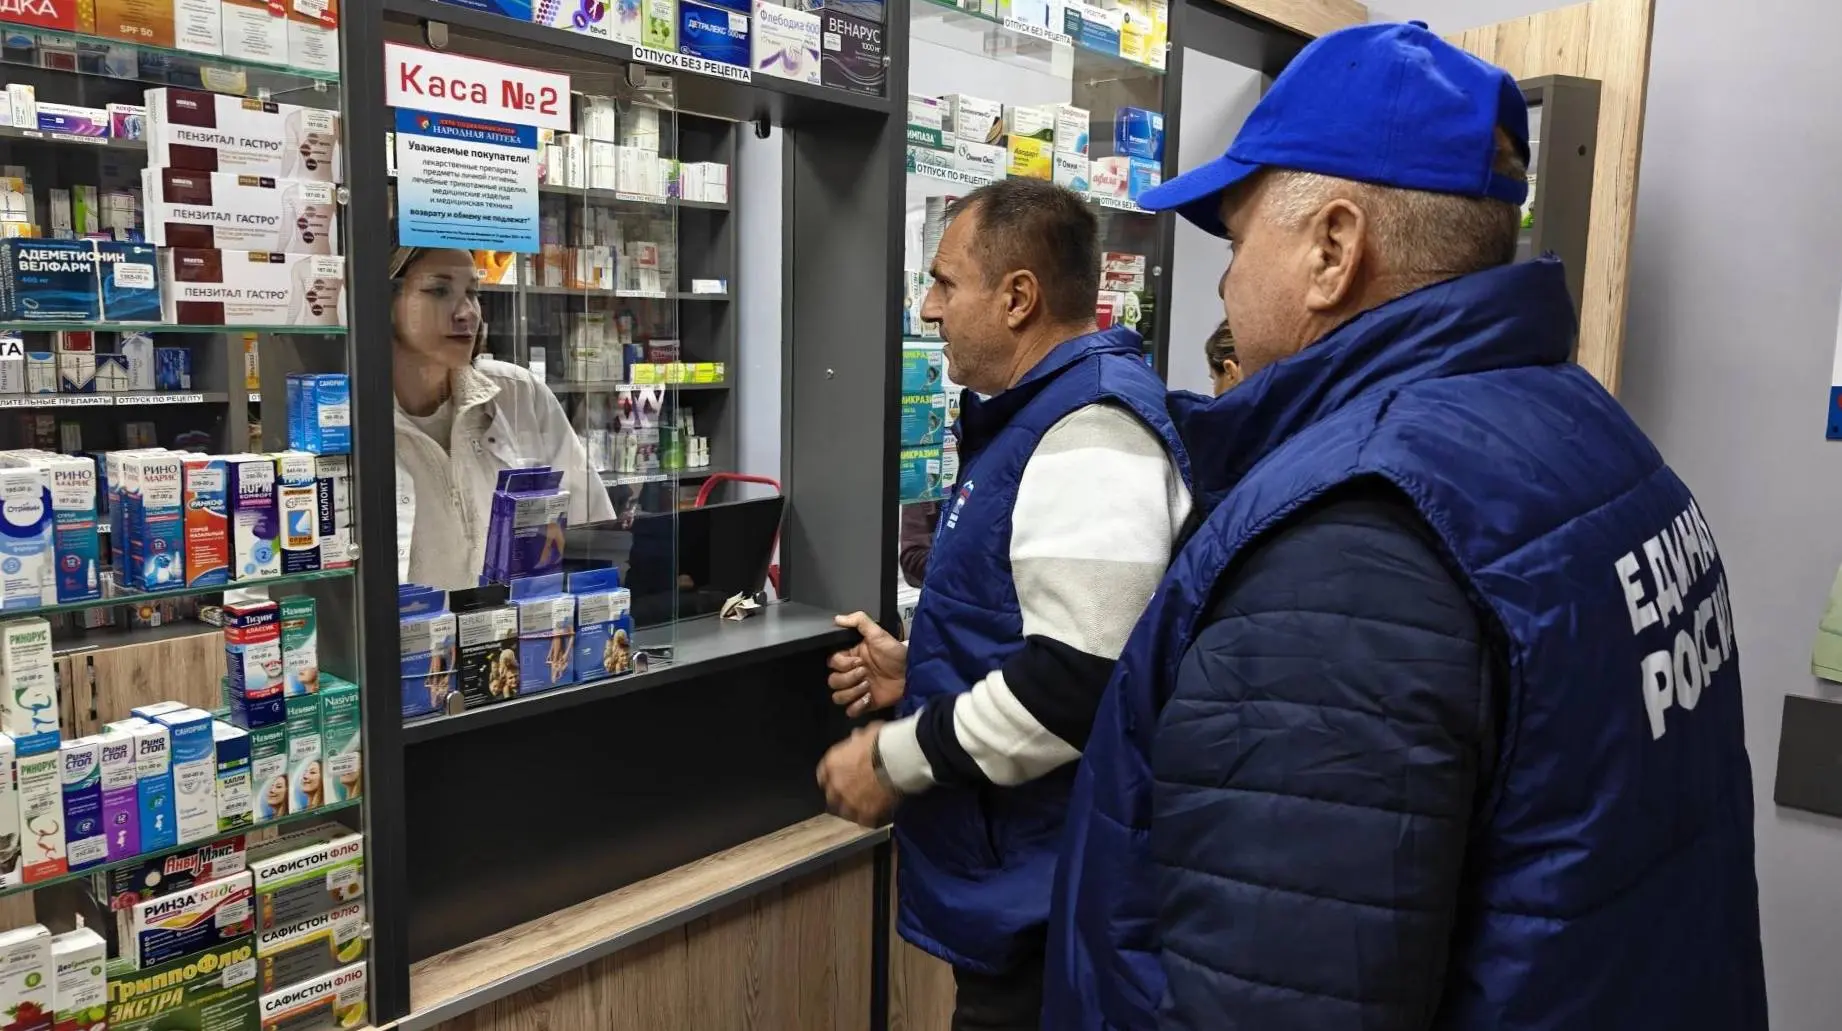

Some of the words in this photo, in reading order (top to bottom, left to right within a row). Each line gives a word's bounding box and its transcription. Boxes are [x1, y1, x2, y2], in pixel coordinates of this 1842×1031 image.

[120, 25, 138, 35] SPF
[140, 28, 153, 37] 50
[590, 25, 607, 36] teva
[688, 18, 727, 36] ДЕТРАЛЕКС
[829, 17, 881, 44] ВЕНАРУС
[1005, 19, 1030, 32] ОТПУСК
[1031, 25, 1043, 36] БЕЗ
[1044, 29, 1071, 45] РЕЦЕПТА
[862, 42, 875, 52] 1000
[635, 47, 679, 66] ОТПУСК
[681, 56, 701, 70] БЕЗ
[704, 61, 750, 81] РЕЦЕПТА
[400, 62, 487, 104] Каса
[502, 80, 558, 115] №2
[177, 130, 235, 145] ПЕНЗИТАЛ
[433, 125, 484, 139] НАРОДНАЯ
[486, 131, 521, 144] АПТЕКА
[408, 140, 469, 157] Уважаемые
[471, 149, 530, 164] покупатели!
[422, 159, 478, 170] лекарственные
[423, 168, 460, 178] предметы
[917, 164, 946, 178] ОТПУСК
[947, 171, 958, 180] ПО
[960, 174, 992, 186] РЕЦЕПТУ
[412, 176, 448, 186] лечебные
[450, 180, 497, 192] трикотажные
[432, 188, 480, 198] медицинские
[436, 198, 484, 208] медицинская
[486, 202, 513, 210] техника
[173, 209, 231, 222] ПЕНЗИТАЛ
[410, 208, 446, 219] возврату
[453, 210, 481, 222] обмену
[18, 249, 126, 262] АДЕМЕТИОНИН
[19, 261, 91, 273] ВЕЛФАРМ
[185, 287, 241, 298] ПЕНЗИТАЛ
[59, 397, 112, 406] ПРЕПАРАТЫ
[118, 396, 150, 404] ОТПУСК
[167, 395, 202, 403] РЕЦЕПТУ
[55, 469, 92, 480] РИНО
[144, 464, 177, 475] РИНО
[1614, 497, 1716, 635] ЕДИНА
[244, 613, 273, 625] Тизин
[10, 630, 47, 645] РИНОРУС
[1640, 572, 1733, 741] РОССИ
[325, 693, 357, 708] Nasivin
[20, 760, 57, 775] РИНОРУС
[260, 851, 328, 879] САФИСТОН
[330, 843, 359, 858] ФЛЮ
[144, 894, 196, 918] РИНЗА
[262, 914, 329, 943] САФИСТОН
[330, 904, 360, 920] ФЛЮ
[108, 945, 252, 1004] ГриппоФлю
[265, 981, 332, 1011] САФИСТОН
[334, 970, 363, 986] ФЛЮ
[109, 987, 185, 1023] ЭКСТРА
